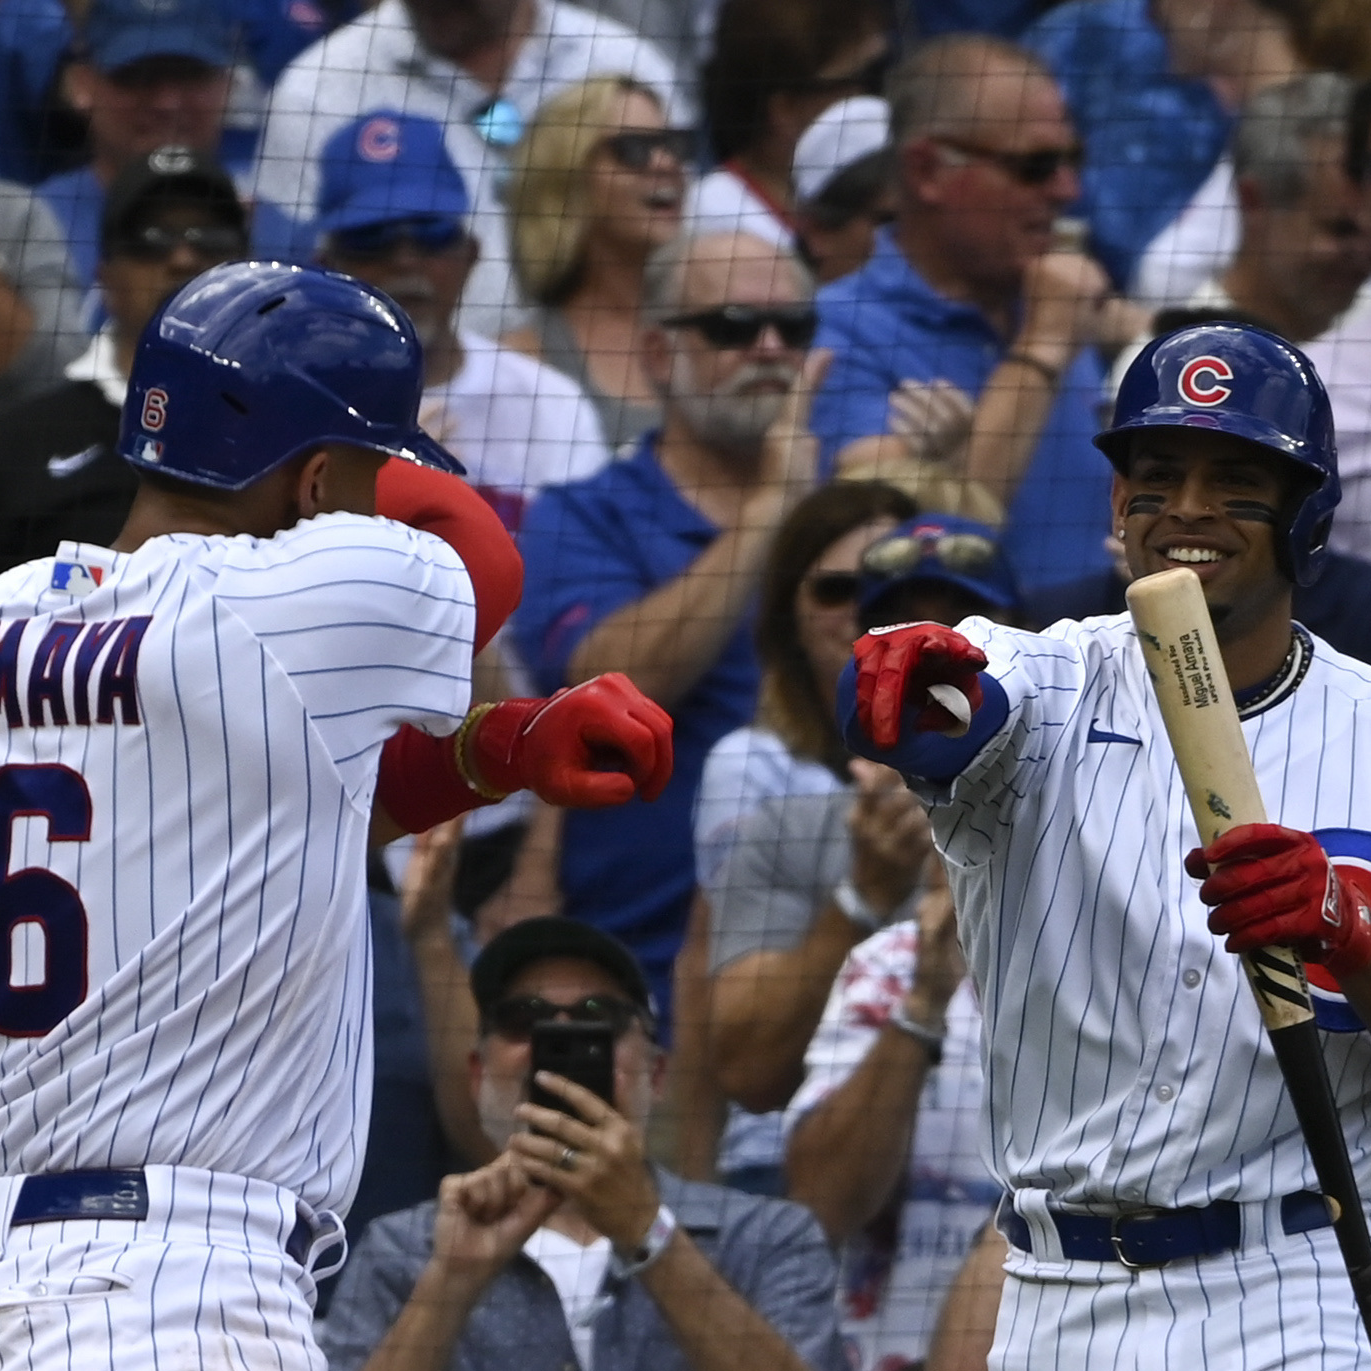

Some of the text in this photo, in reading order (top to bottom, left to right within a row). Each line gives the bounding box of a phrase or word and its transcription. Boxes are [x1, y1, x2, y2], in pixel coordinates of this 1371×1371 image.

[1178, 355, 1234, 407] C
[141, 387, 169, 432] 6
[1179, 633, 1209, 709] Miguel Amaya
